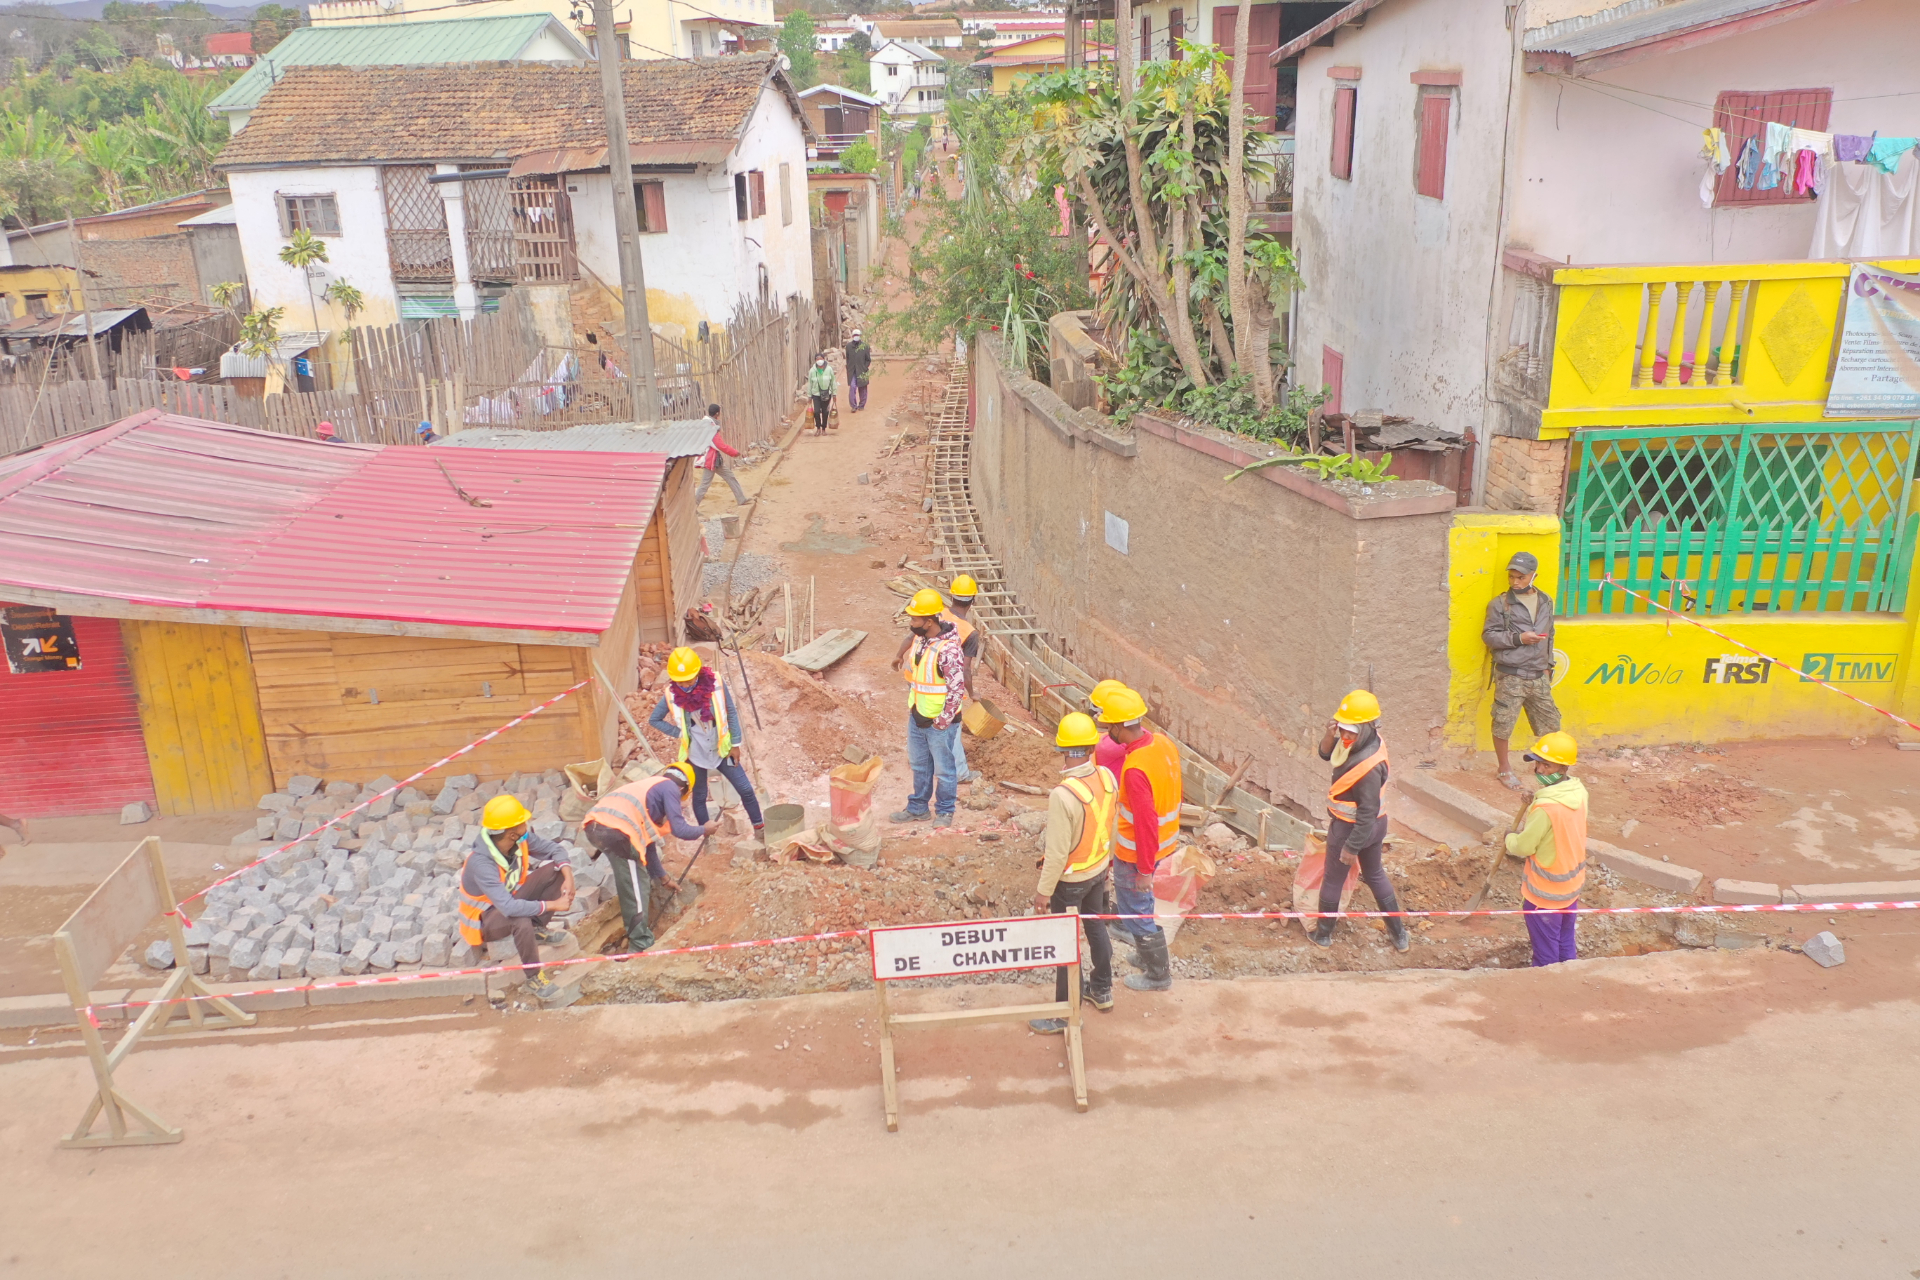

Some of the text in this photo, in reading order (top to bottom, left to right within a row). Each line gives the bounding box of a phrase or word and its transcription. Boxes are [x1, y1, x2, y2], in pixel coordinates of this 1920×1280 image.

[1719, 653, 1759, 664] Telma
[1836, 661, 1893, 680] TMV
[941, 928, 1008, 947] DEBUT
[894, 945, 1056, 972] DE CHANTIER
